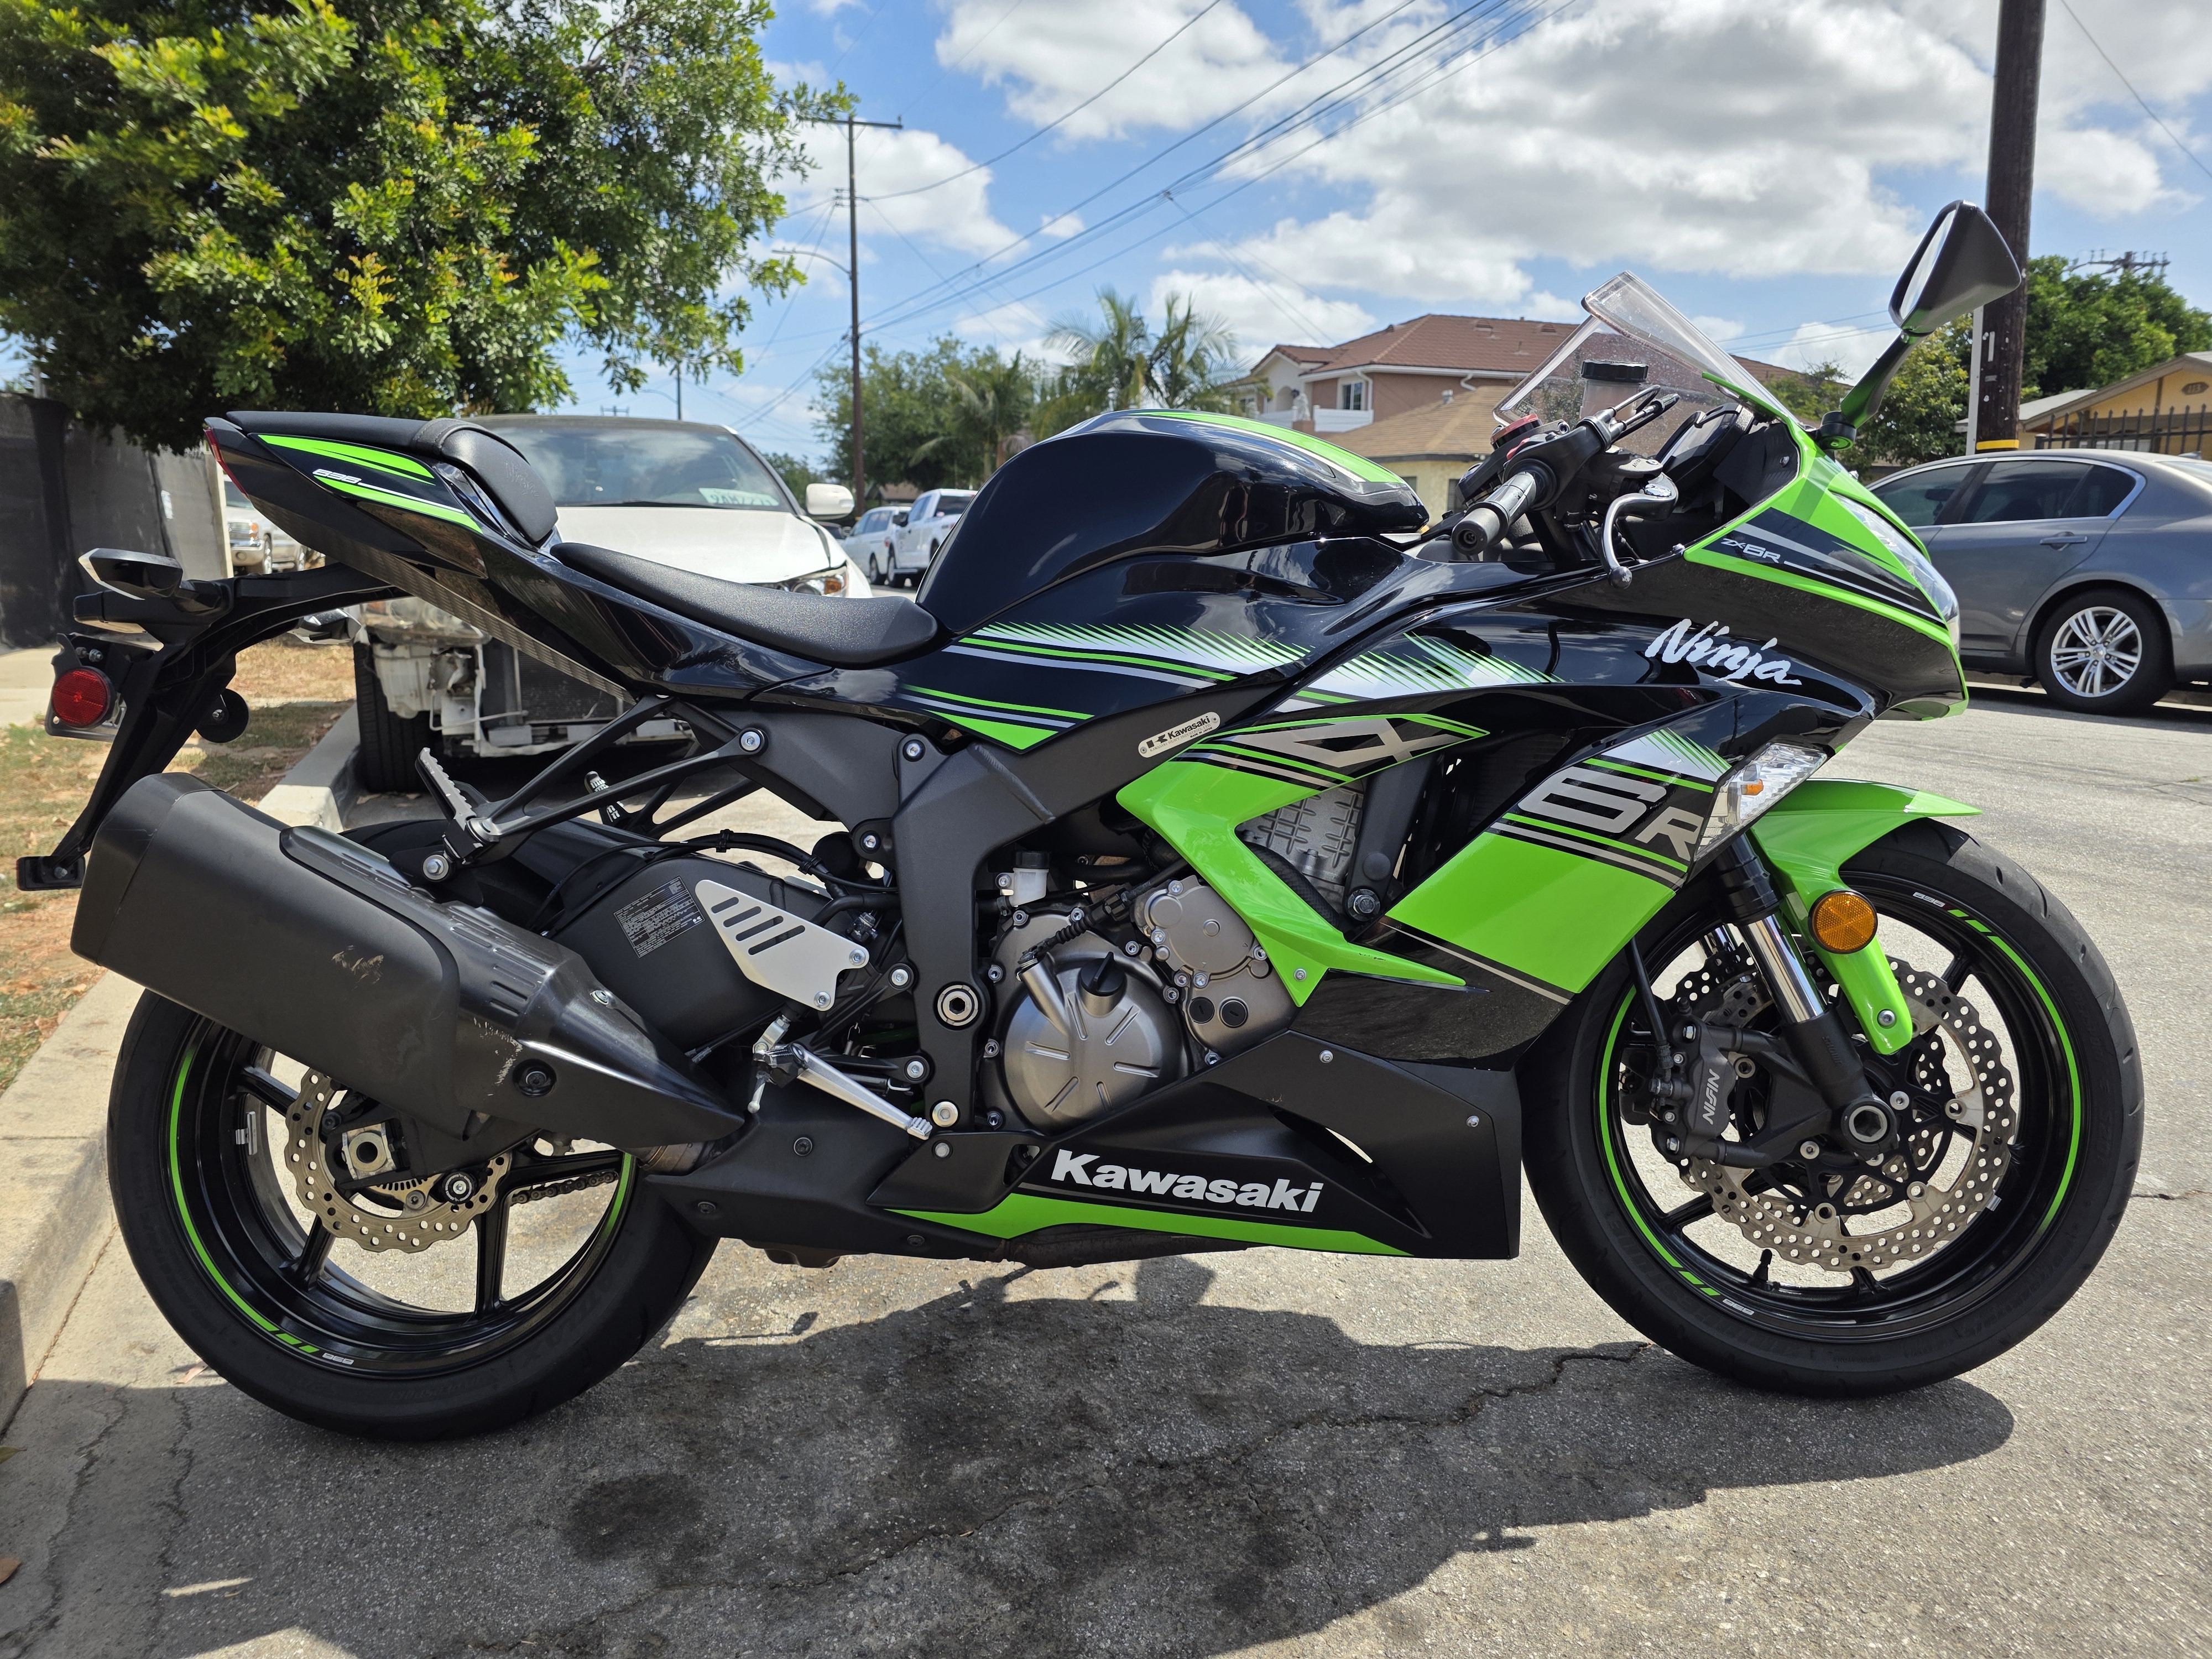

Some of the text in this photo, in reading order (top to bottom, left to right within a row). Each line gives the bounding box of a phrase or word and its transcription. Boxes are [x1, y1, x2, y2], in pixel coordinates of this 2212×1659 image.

[312, 468, 362, 484] 636
[1721, 538, 1781, 564] ZX-6R
[1645, 618, 1802, 685] Ninja
[1167, 716, 1211, 739] Kawasaki
[1150, 742, 1168, 752] KAWASAKI
[1913, 892, 1945, 907] 636
[1051, 1149, 1324, 1213] Kawasaki
[1722, 1298, 1755, 1316] 636
[322, 1353, 354, 1365] 636
